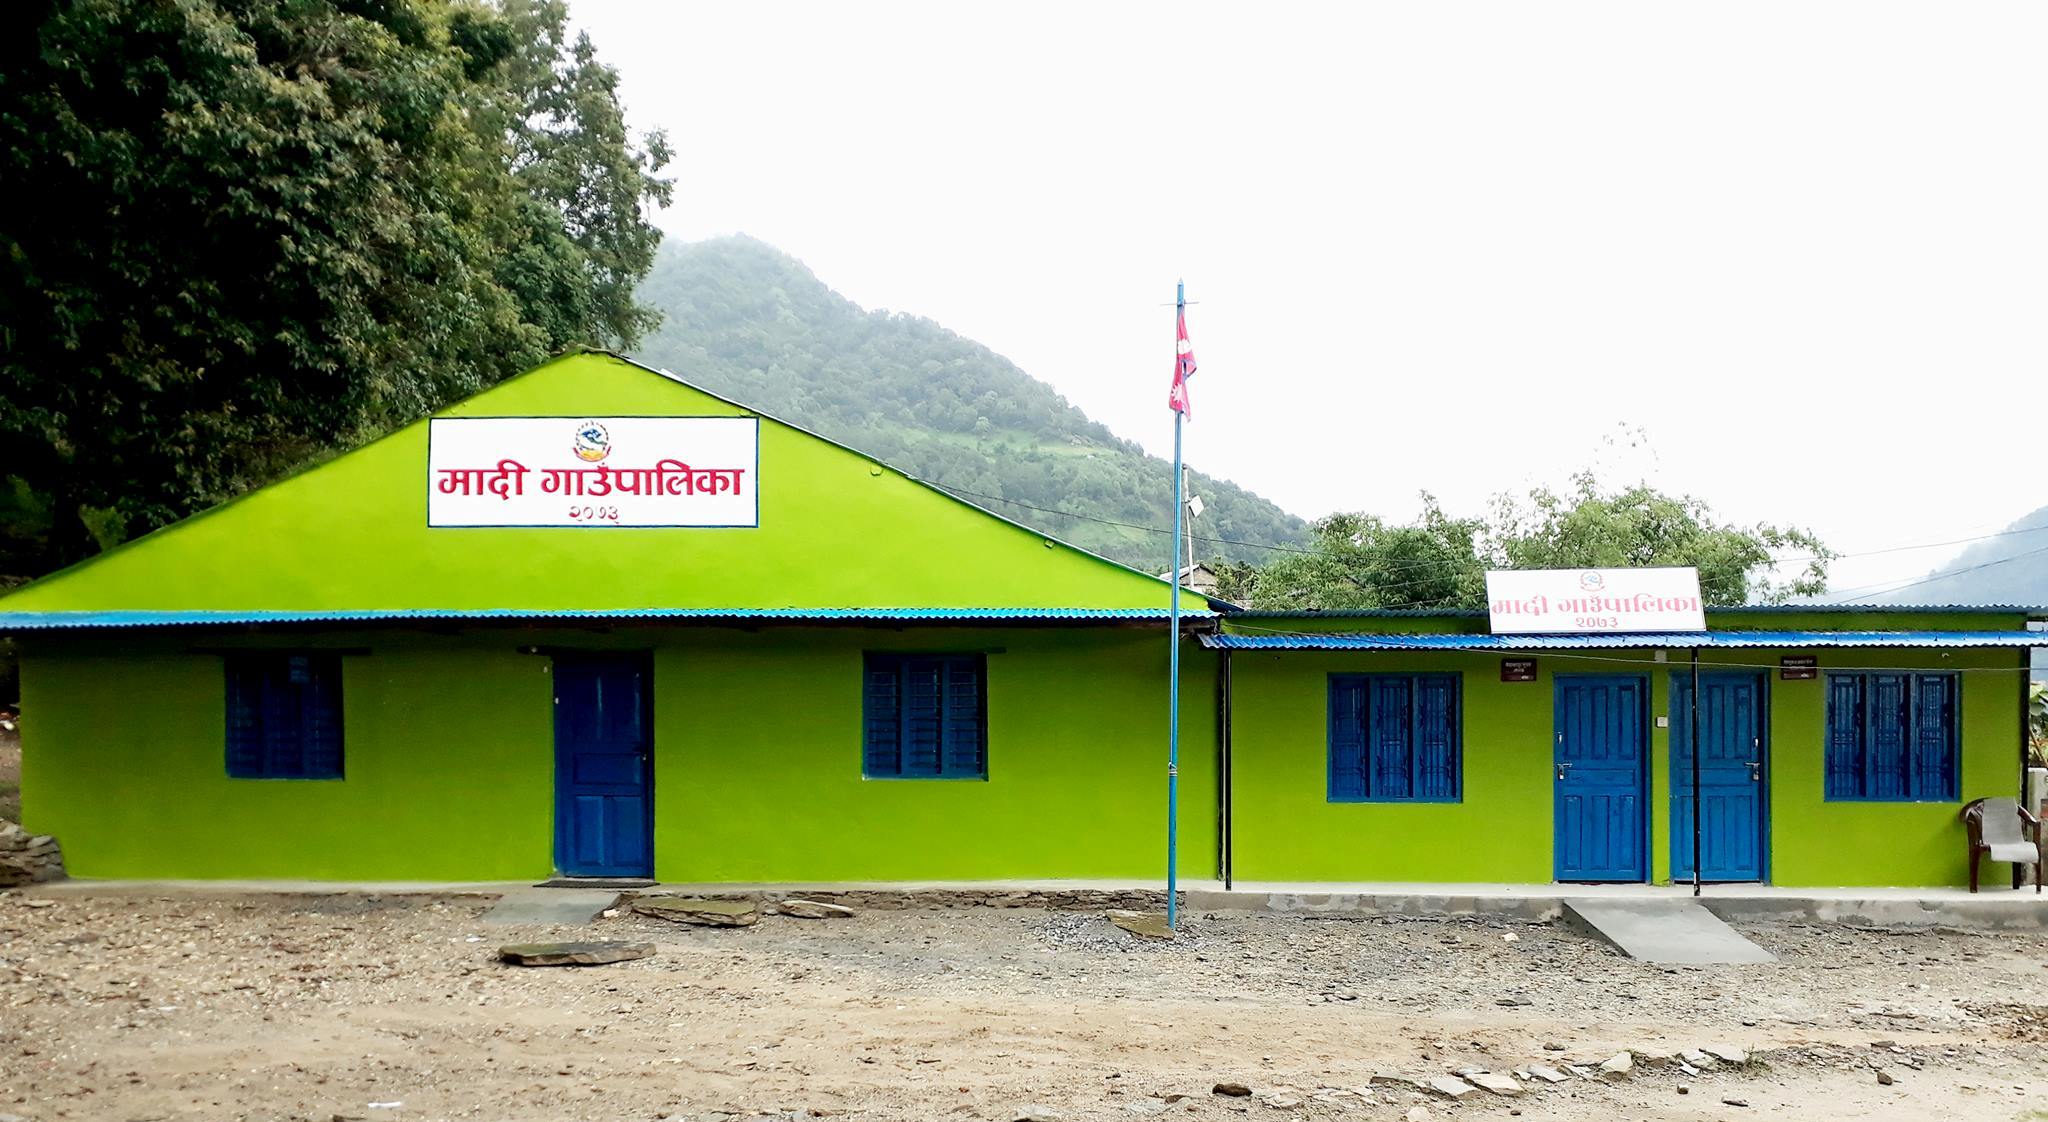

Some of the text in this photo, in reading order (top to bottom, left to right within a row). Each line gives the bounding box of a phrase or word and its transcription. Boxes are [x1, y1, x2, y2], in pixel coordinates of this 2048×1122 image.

[437, 458, 746, 501] मादी गाउँपालिका
[568, 505, 620, 524] २०७३
[1490, 593, 1698, 616] मादी गाउँपालिका
[1575, 616, 1619, 629] २०७३
